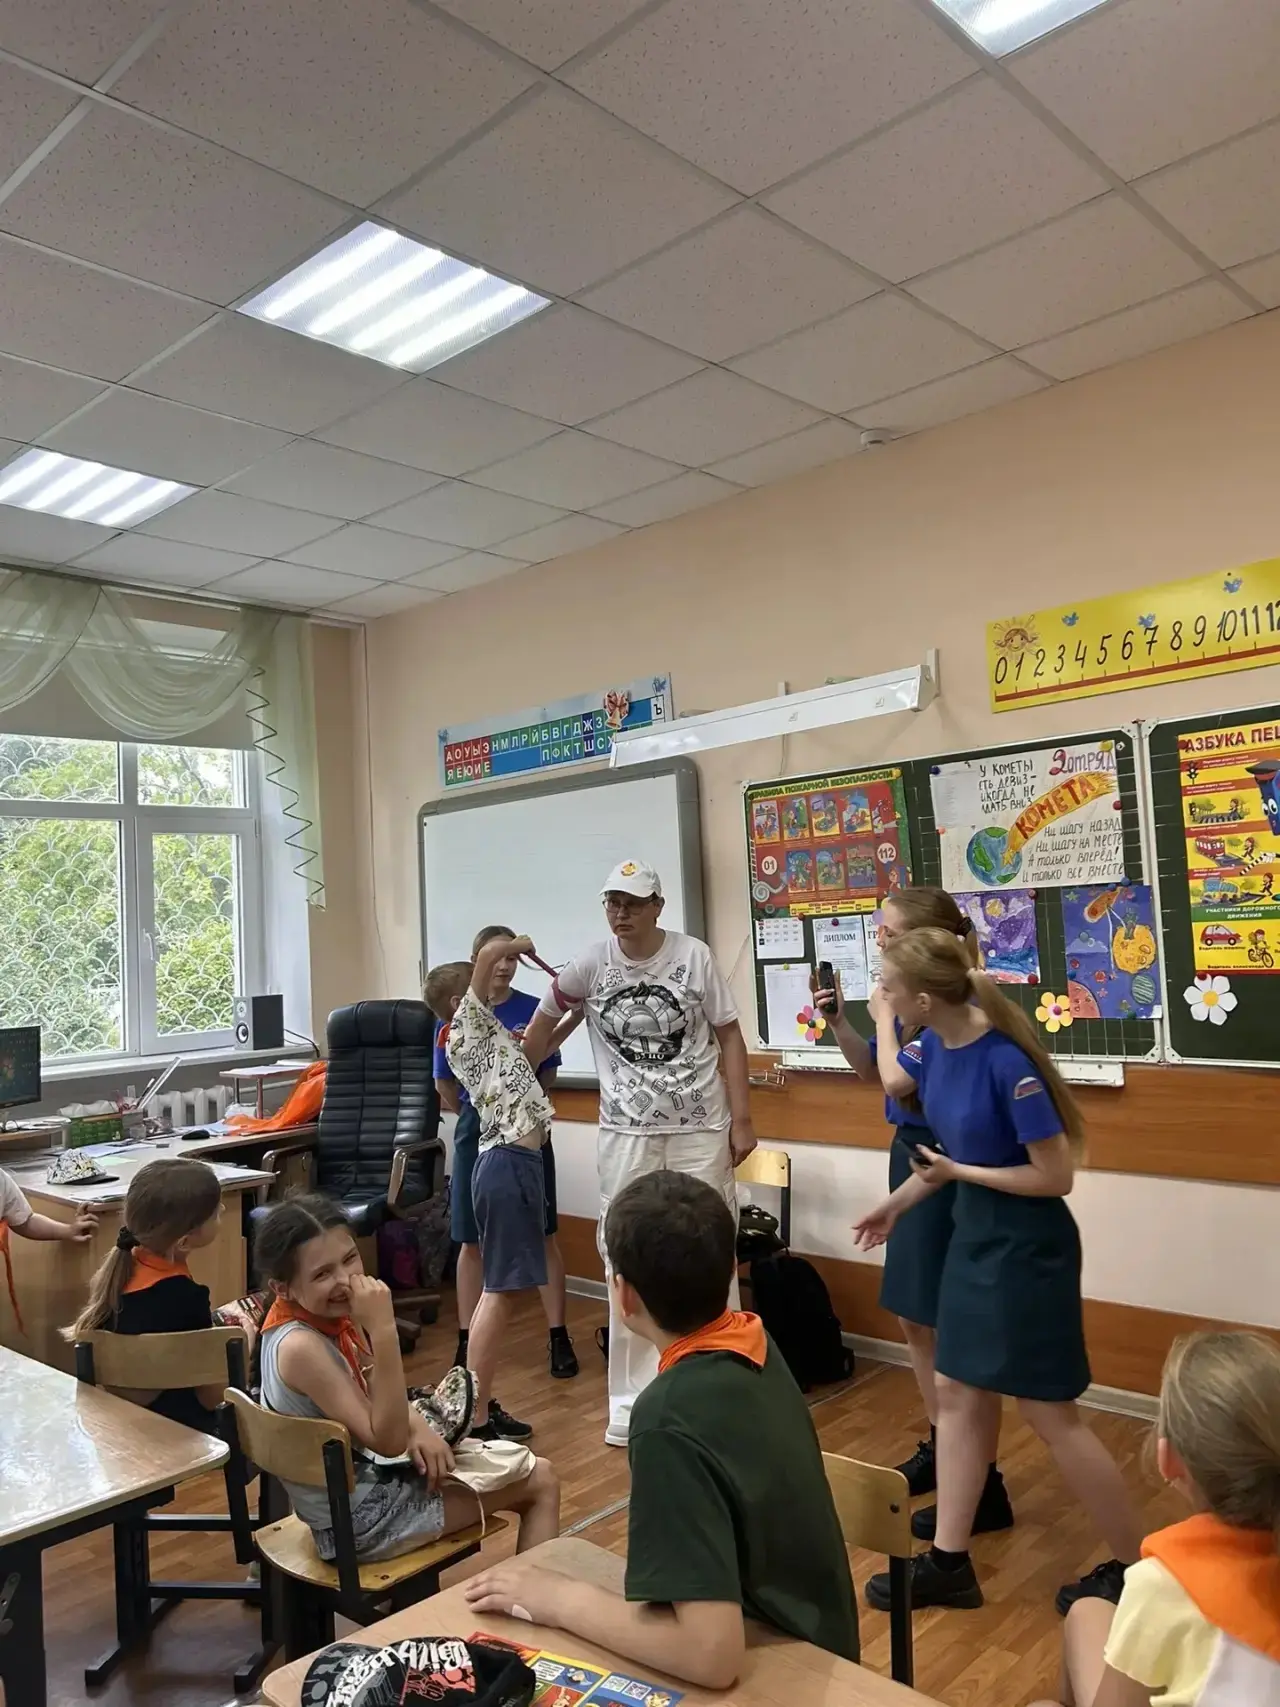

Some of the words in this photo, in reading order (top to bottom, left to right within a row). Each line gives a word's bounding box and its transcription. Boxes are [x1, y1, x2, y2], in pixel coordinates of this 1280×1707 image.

[995, 657, 1007, 684] 0
[1015, 652, 1024, 681] 1
[1033, 649, 1046, 678] 2
[1054, 644, 1066, 673] 3
[1074, 640, 1087, 668] 4
[1096, 635, 1112, 666] 5
[1121, 630, 1134, 661] 6
[1143, 625, 1159, 655] 7
[1170, 621, 1183, 651] 8
[1193, 615, 1207, 647] 9
[1216, 610, 1238, 642] 10
[1240, 605, 1260, 637] 11
[1184, 732, 1245, 752] АЗБУКА
[992, 759, 1033, 776] КОМЕТЫ
[784, 778, 829, 793] ПОЖАРНОЙ
[981, 787, 1016, 802] ИКОГДА
[1015, 775, 1096, 840] КОМЕТА
[823, 933, 856, 943] ДИПЛОМ
[868, 931, 880, 940] ГР
